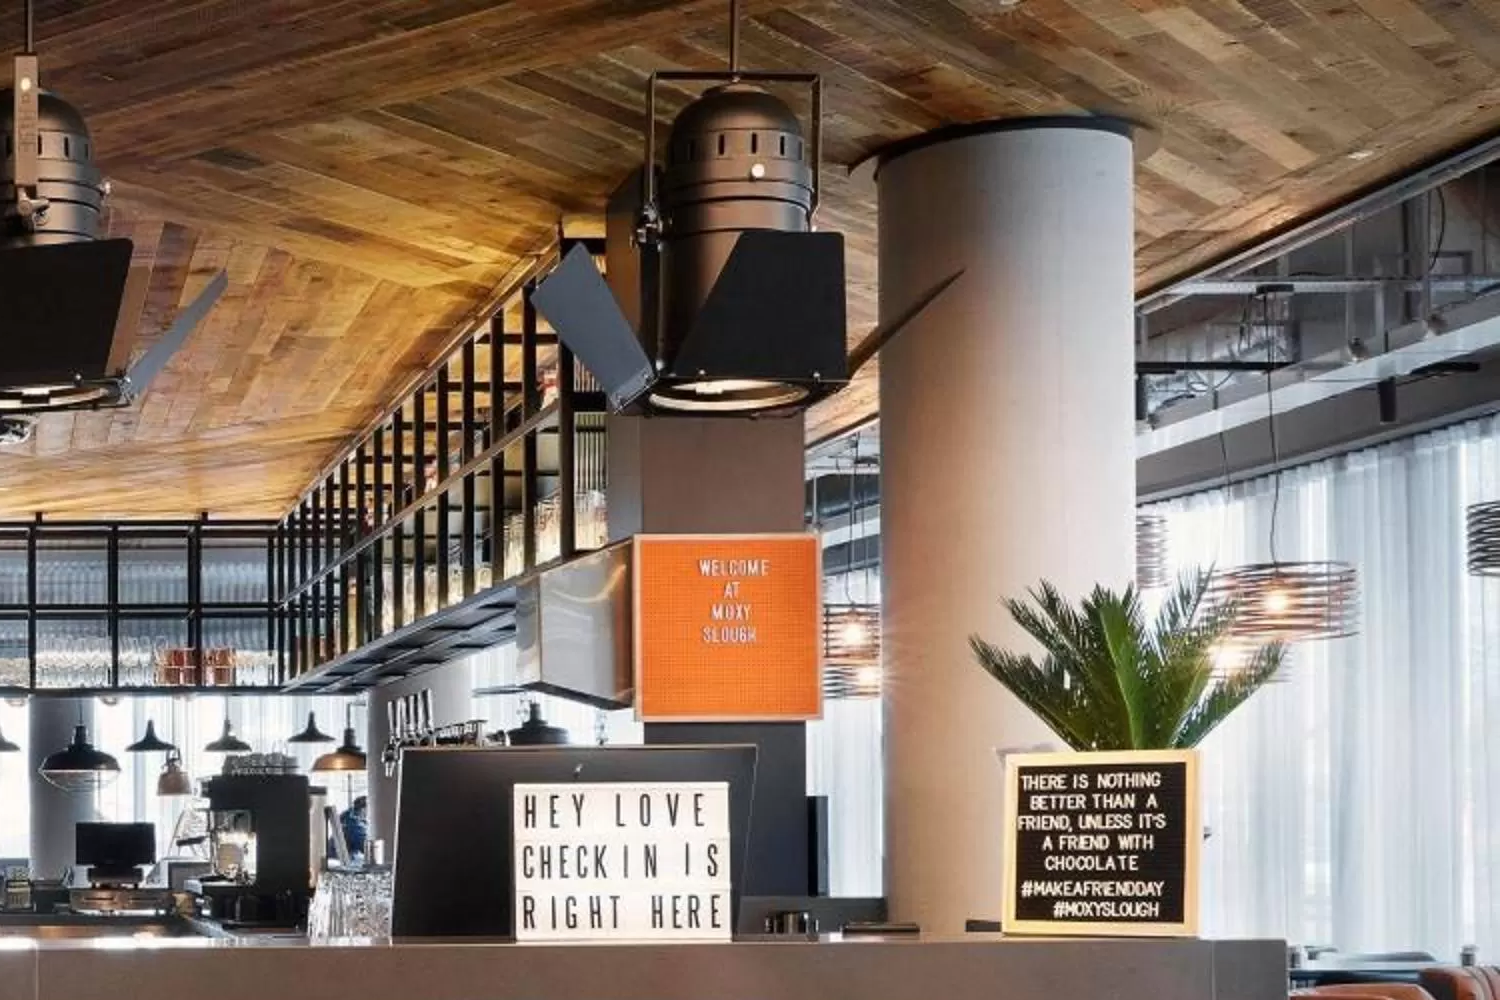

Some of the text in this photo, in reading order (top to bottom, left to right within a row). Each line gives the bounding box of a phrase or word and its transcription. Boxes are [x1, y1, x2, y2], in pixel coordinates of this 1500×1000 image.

[699, 559, 770, 577] WELCOME
[723, 581, 741, 599] AT
[711, 603, 752, 621] MOXY
[702, 625, 757, 643] SLOUGH
[1021, 772, 1161, 791] THERE IS NOTHING
[524, 793, 705, 829] HEY LOVE
[1030, 793, 1158, 811] BETTER THAN A
[1017, 813, 1167, 833] FRIEND, UNLESS IT'S
[1042, 834, 1154, 851] A FRIEND WITH
[685, 842, 719, 877] IS
[1044, 855, 1139, 871] CHOCOLATE
[1021, 880, 1164, 898] #MAKEAFRIENDDAY
[523, 894, 722, 930] RIGHT HERE
[1053, 902, 1159, 918] #MOXYSLOUGH
